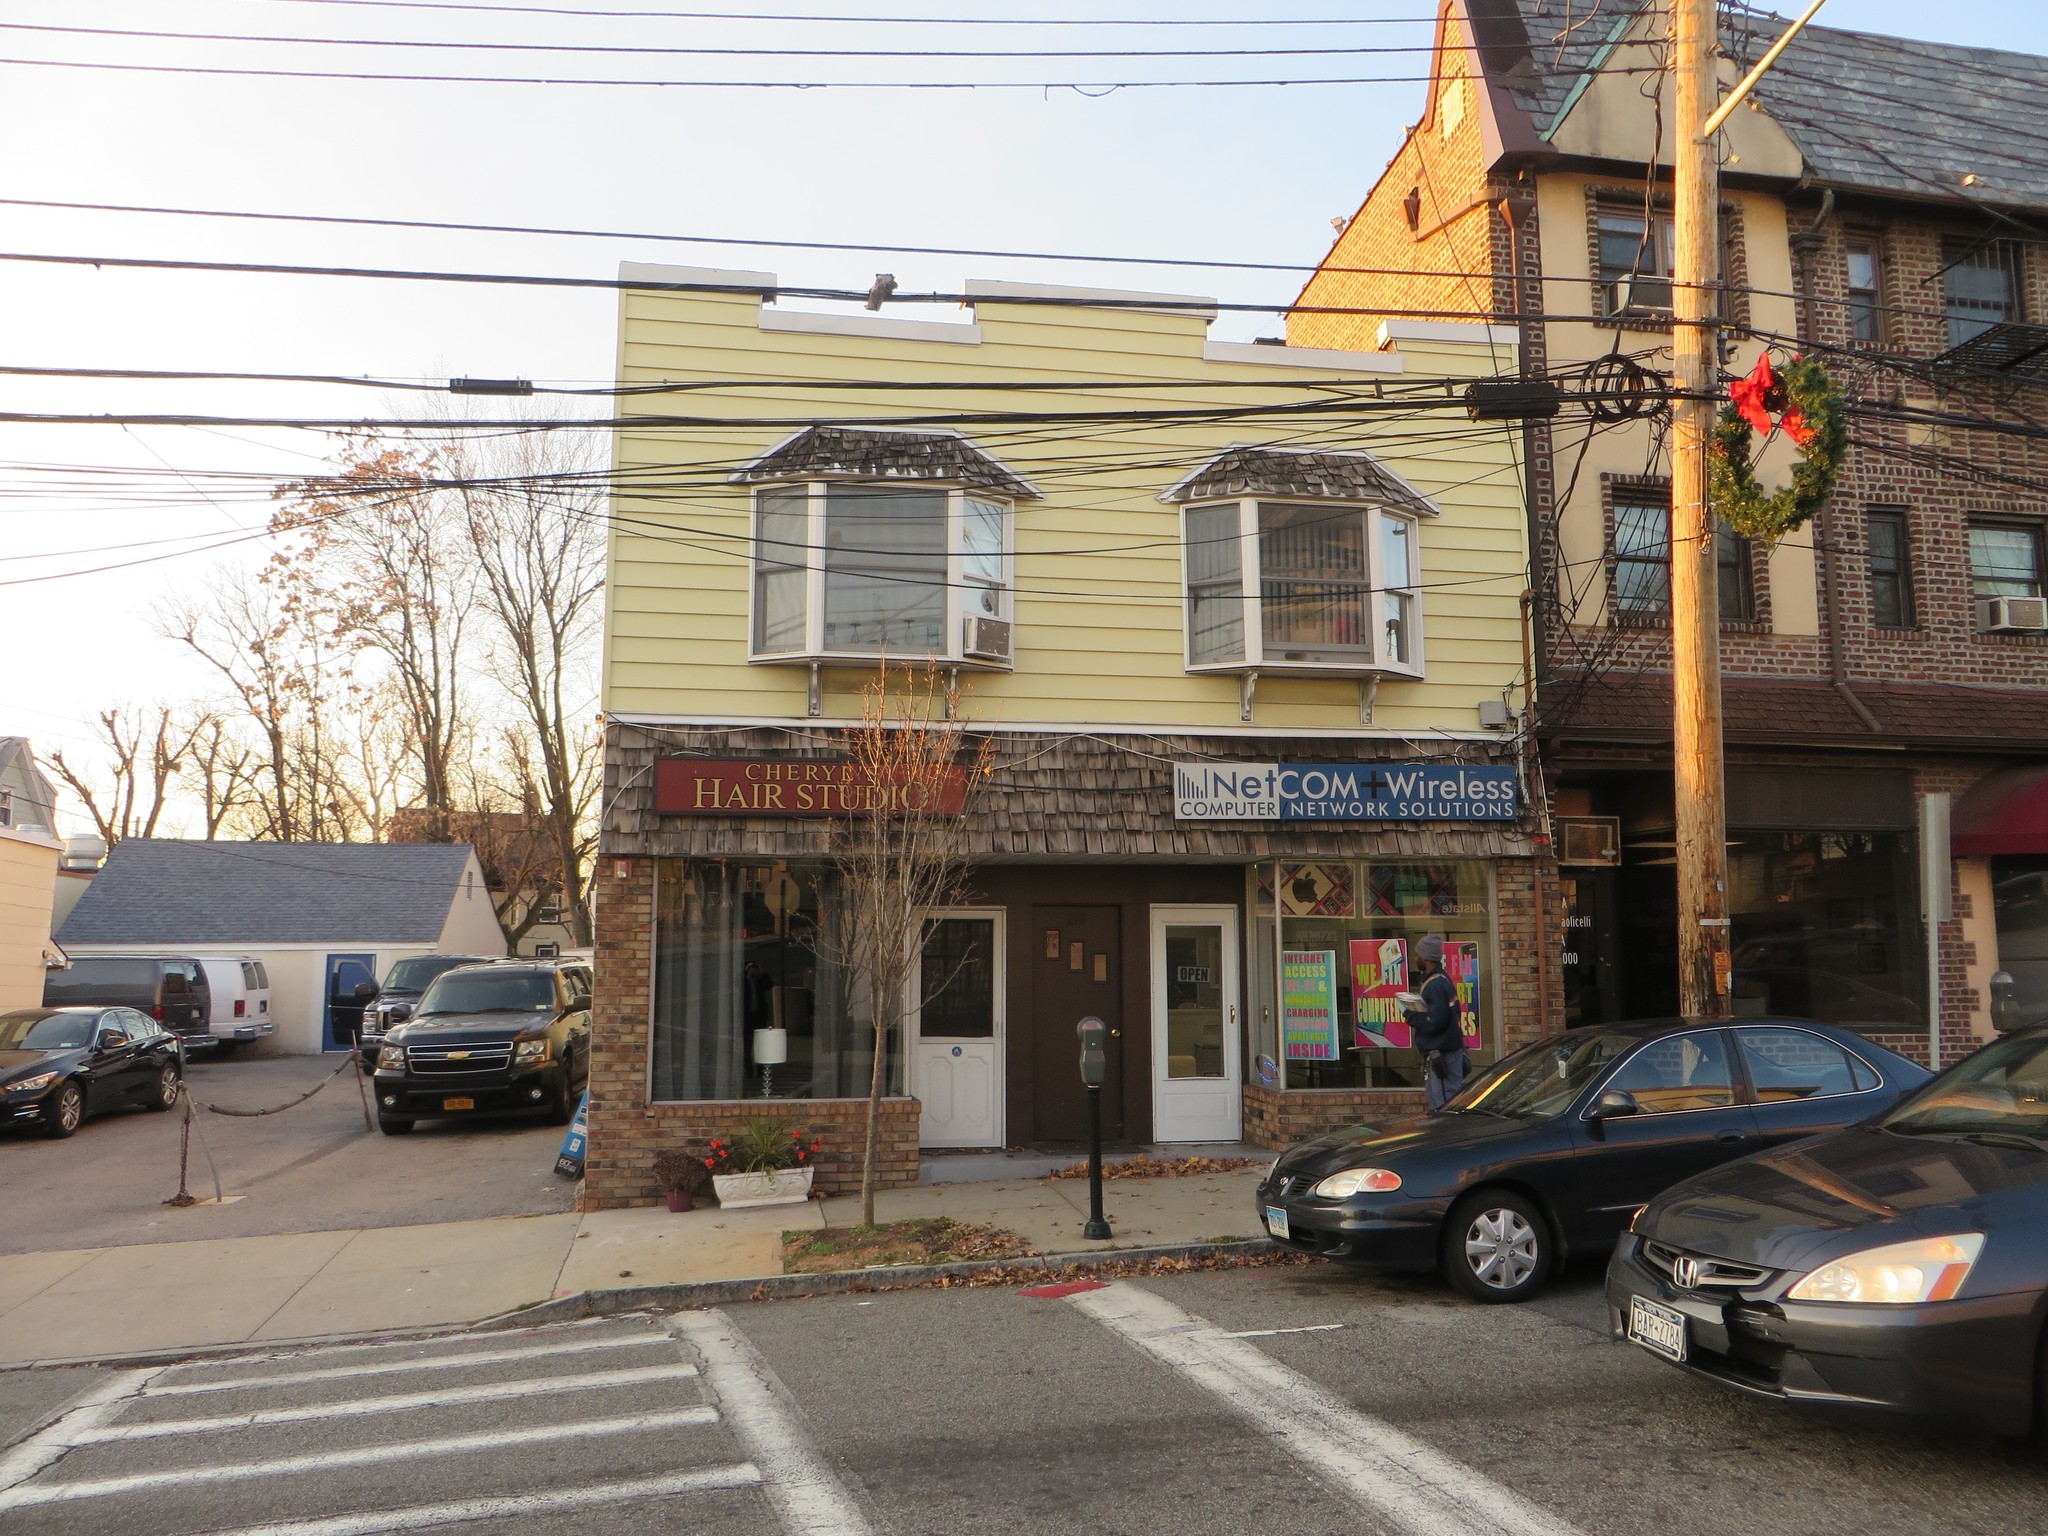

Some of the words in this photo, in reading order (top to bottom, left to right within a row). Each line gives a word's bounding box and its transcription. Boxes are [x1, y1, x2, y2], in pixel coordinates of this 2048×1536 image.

[692, 777, 787, 810] HAIR
[796, 783, 930, 812] STUDIO
[1399, 801, 1514, 818] SOLUTIONS
[1561, 915, 1591, 928] aolicelli
[1284, 953, 1327, 964] INTERNET
[1451, 954, 1473, 975] FIX
[1180, 967, 1208, 982] OPEN
[1285, 965, 1327, 978] ACCESS
[1356, 964, 1377, 985] WE
[1381, 963, 1403, 986] FIX
[1286, 993, 1328, 1006] MOBILE
[1286, 1007, 1329, 1018] CHARGING
[1287, 1019, 1329, 1031] STATION
[1288, 1031, 1330, 1042] AVAILABLE
[1288, 1043, 1331, 1058] INSIDE
